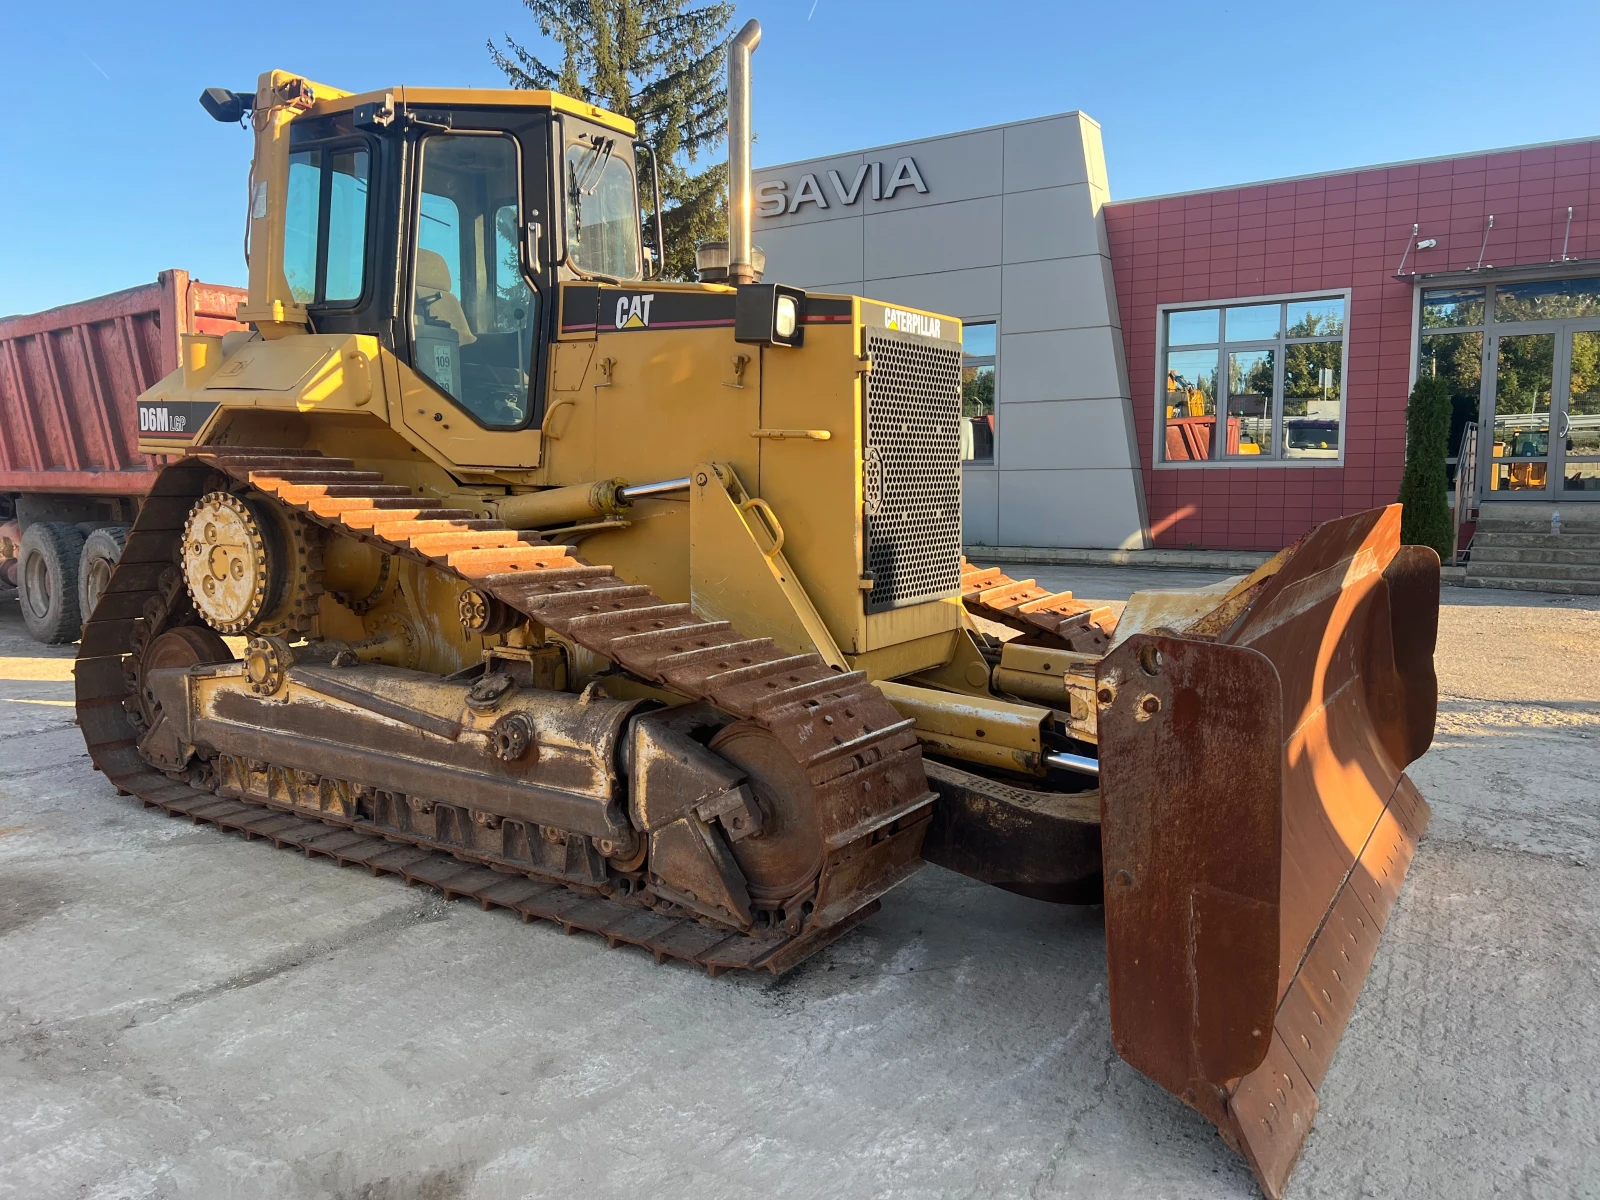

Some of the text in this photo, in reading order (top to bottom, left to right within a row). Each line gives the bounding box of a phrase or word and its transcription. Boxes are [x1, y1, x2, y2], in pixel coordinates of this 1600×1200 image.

[754, 156, 930, 218] SAVIA
[615, 294, 655, 329] CAT
[884, 307, 941, 339] CATERPILLAR
[435, 356, 451, 368] 109
[139, 407, 187, 432] D6M LGP
